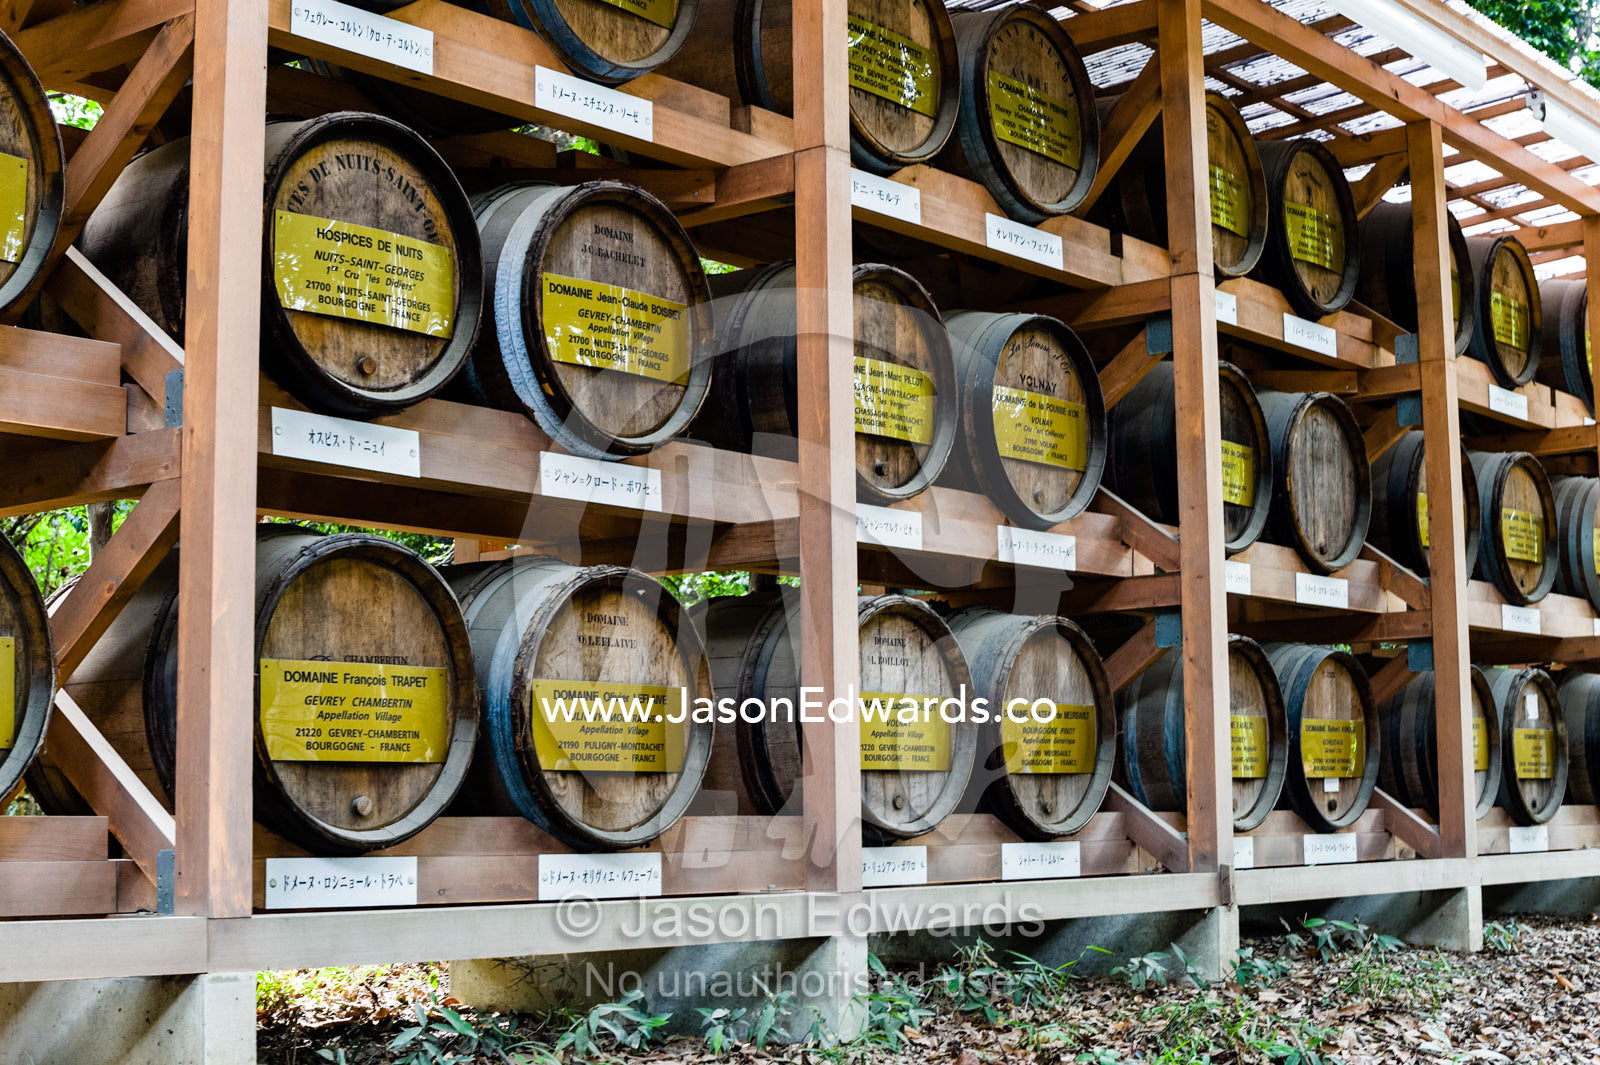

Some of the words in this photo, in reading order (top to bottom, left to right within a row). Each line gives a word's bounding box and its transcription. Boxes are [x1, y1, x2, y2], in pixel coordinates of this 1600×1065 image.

[308, 160, 331, 185] DE
[593, 224, 634, 243] DOMAINE
[316, 227, 373, 249] HOSPICES
[377, 239, 392, 253] DE
[395, 245, 423, 261] NUITS
[313, 249, 425, 282] NUITS-SAINT-GEORGES
[344, 269, 360, 281] Cru
[305, 279, 331, 293] 21700
[336, 284, 431, 313] NUITS-SAINT-GEORGES
[549, 282, 593, 300] DOMAINE
[596, 291, 649, 312] Jean-Claude
[651, 303, 682, 321] BOISSET
[318, 294, 376, 313] BOURGOGNE
[390, 307, 421, 323] FRANCE
[578, 308, 662, 334] GEVREY-CHAMBERTIN
[587, 323, 630, 337] Appellation
[633, 331, 654, 344] Village
[568, 334, 589, 345] 21700
[593, 337, 669, 362] NUITS-SAINT-GEORGES
[579, 347, 626, 363] BOURGOGNE
[637, 358, 661, 371] FRANCE
[1019, 373, 1058, 394] VOLNAY
[1028, 400, 1036, 409] de
[1031, 416, 1053, 427] VOLNAY
[586, 612, 629, 628] DOMAINE
[284, 670, 338, 684] DOMAINE
[343, 673, 387, 688] François
[391, 675, 428, 688] TRAPET
[304, 695, 346, 706] GEVREY
[351, 696, 413, 709] CHAMBERTIN
[316, 710, 369, 722] Appellation
[374, 712, 402, 723] Village
[295, 728, 322, 738] 21220
[328, 728, 420, 740] GEVREY-CHAMBERTIN
[579, 725, 623, 735] Appellation
[627, 727, 649, 737] Village
[871, 730, 904, 739] Appellation
[1022, 726, 1058, 735] BOURGOGNE
[306, 741, 365, 751] BOURGOGNE
[380, 742, 411, 752] FRANCE
[558, 740, 580, 750] 21190
[584, 741, 665, 752] PULIGNY-MONTRACHET
[570, 752, 620, 763] BOURGOGNE
[631, 754, 656, 763] FRANCE
[864, 753, 903, 763] BOURGOGNE
